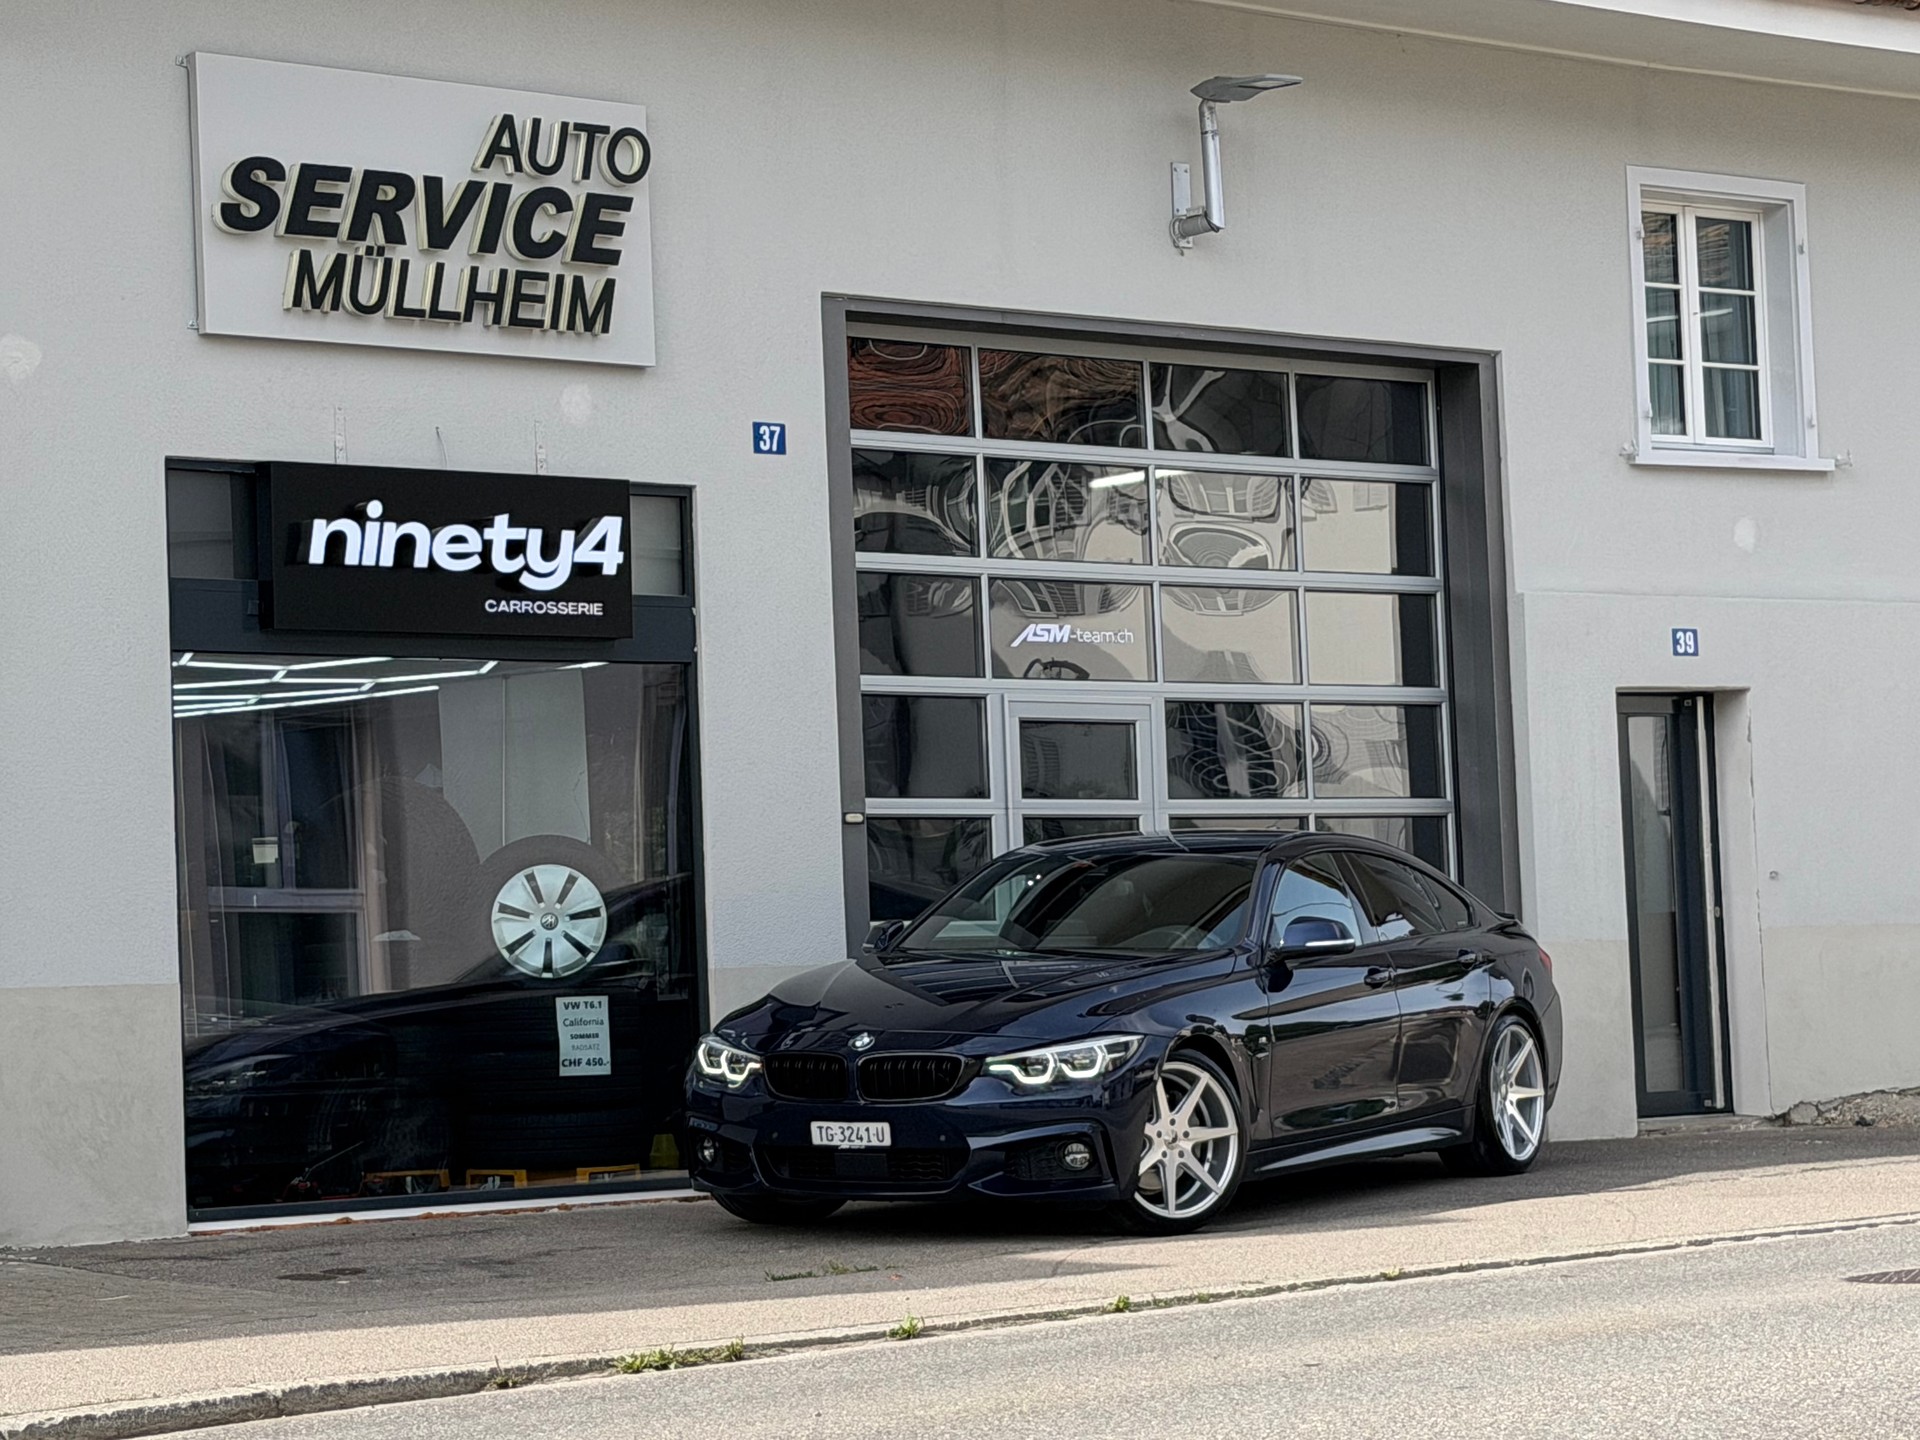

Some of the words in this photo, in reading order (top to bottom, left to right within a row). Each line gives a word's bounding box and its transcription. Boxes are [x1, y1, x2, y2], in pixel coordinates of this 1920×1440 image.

[475, 113, 651, 185] AUTO
[214, 155, 634, 266] SERVICE
[285, 246, 616, 335] MÜLLHEIM
[759, 425, 780, 452] 37
[308, 499, 625, 591] ninety4
[485, 599, 604, 617] CARROSSERIE
[1676, 631, 1695, 654] 39
[563, 1001, 581, 1010] VW
[583, 1001, 602, 1009] T6.1
[563, 1017, 605, 1027] California
[562, 1058, 583, 1067] CHF
[585, 1057, 610, 1067] 450.-
